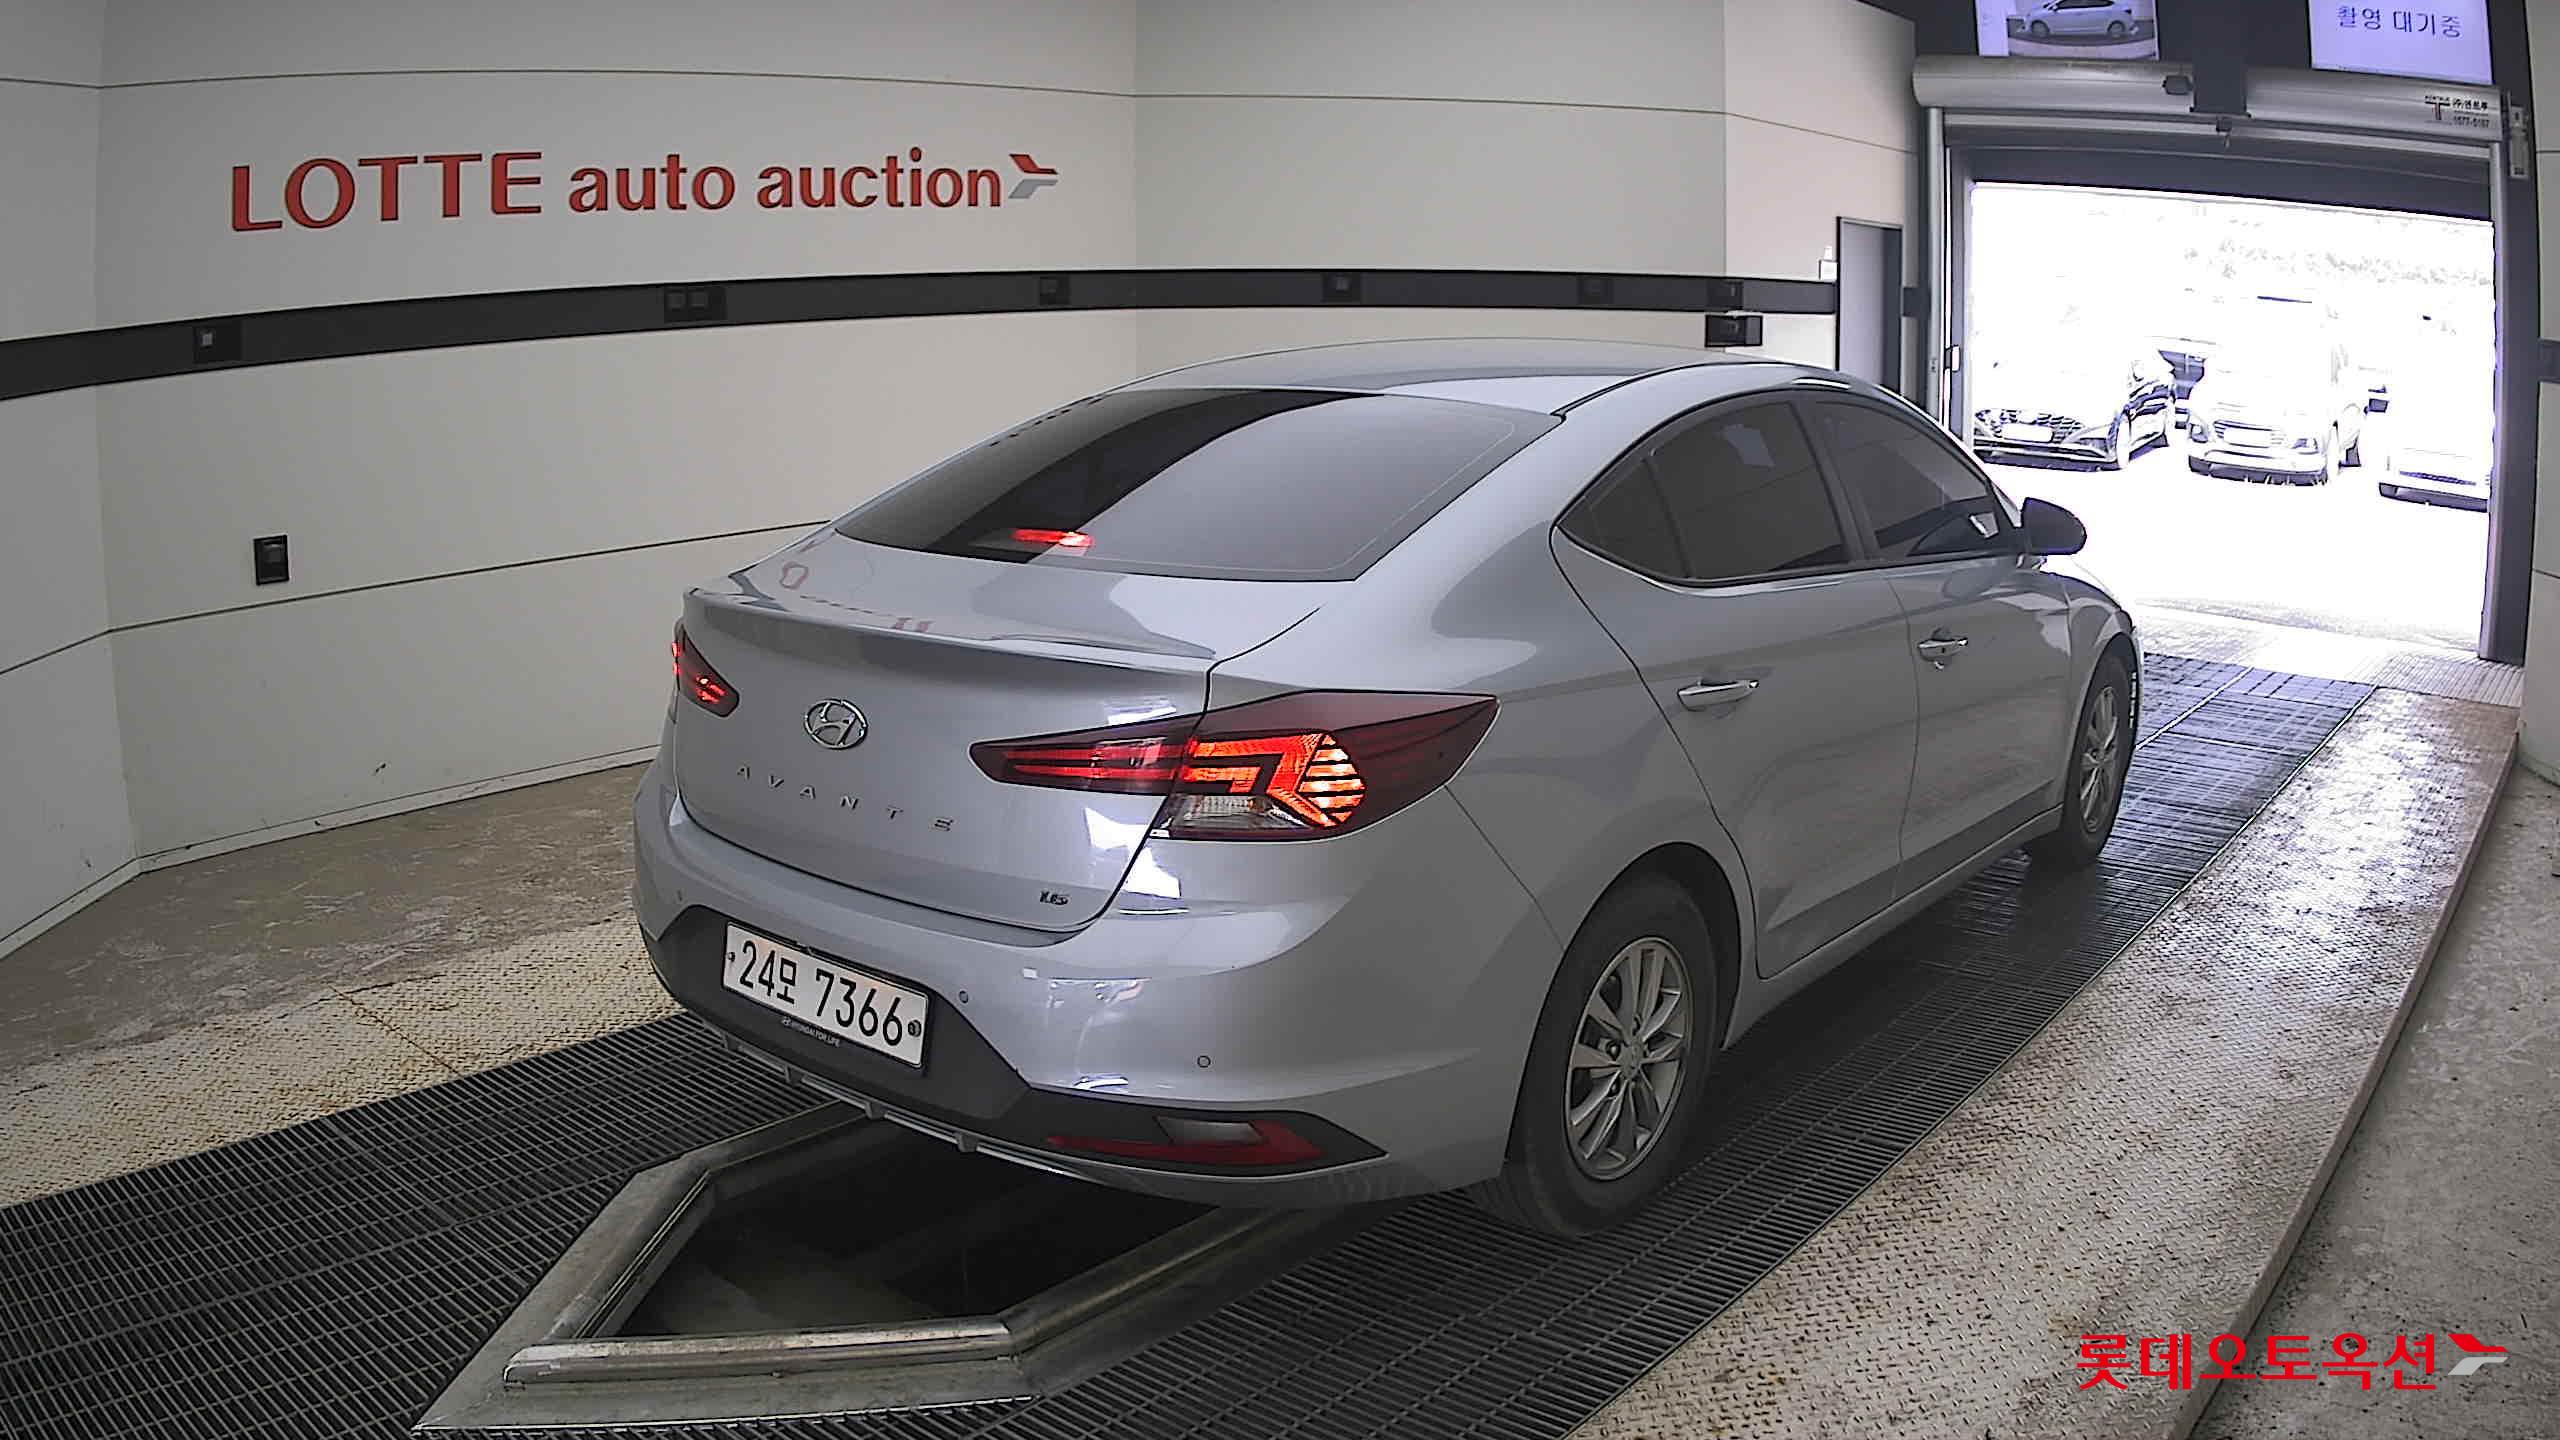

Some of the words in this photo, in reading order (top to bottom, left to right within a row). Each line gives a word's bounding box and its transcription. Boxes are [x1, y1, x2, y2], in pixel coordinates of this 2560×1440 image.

[2337, 6, 2382, 31] 촬영
[2392, 10, 2463, 39] 대기중
[231, 151, 543, 232] LOTTE
[568, 153, 737, 212] auto
[756, 146, 1001, 209] auction
[736, 764, 955, 833] AVANTE
[739, 940, 797, 1005] 24모
[815, 967, 903, 1047] 7366
